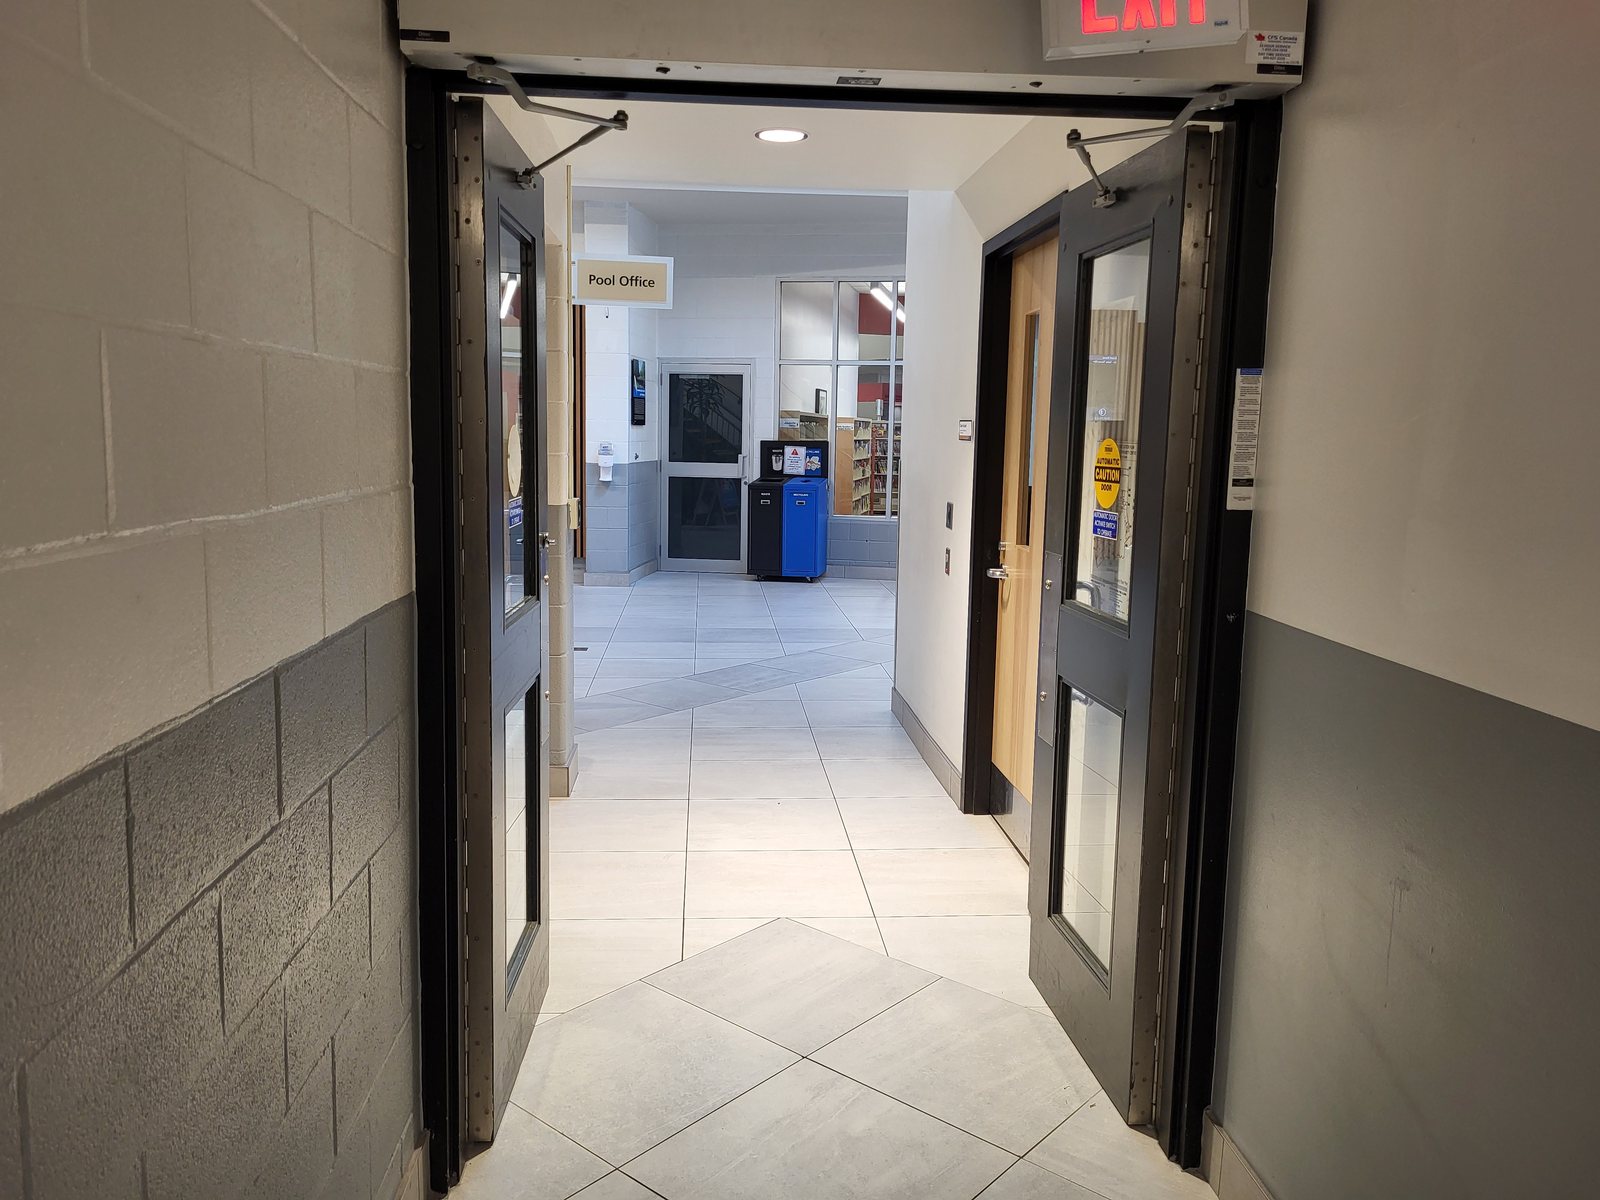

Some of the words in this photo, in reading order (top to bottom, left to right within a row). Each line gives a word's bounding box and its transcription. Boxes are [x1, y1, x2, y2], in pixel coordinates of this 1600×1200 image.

[589, 274, 615, 286] Pool
[619, 275, 655, 288] Office
[1097, 457, 1120, 466] AUTOMATIC
[1095, 468, 1120, 482] CAUTION
[1101, 483, 1112, 492] DOOR
